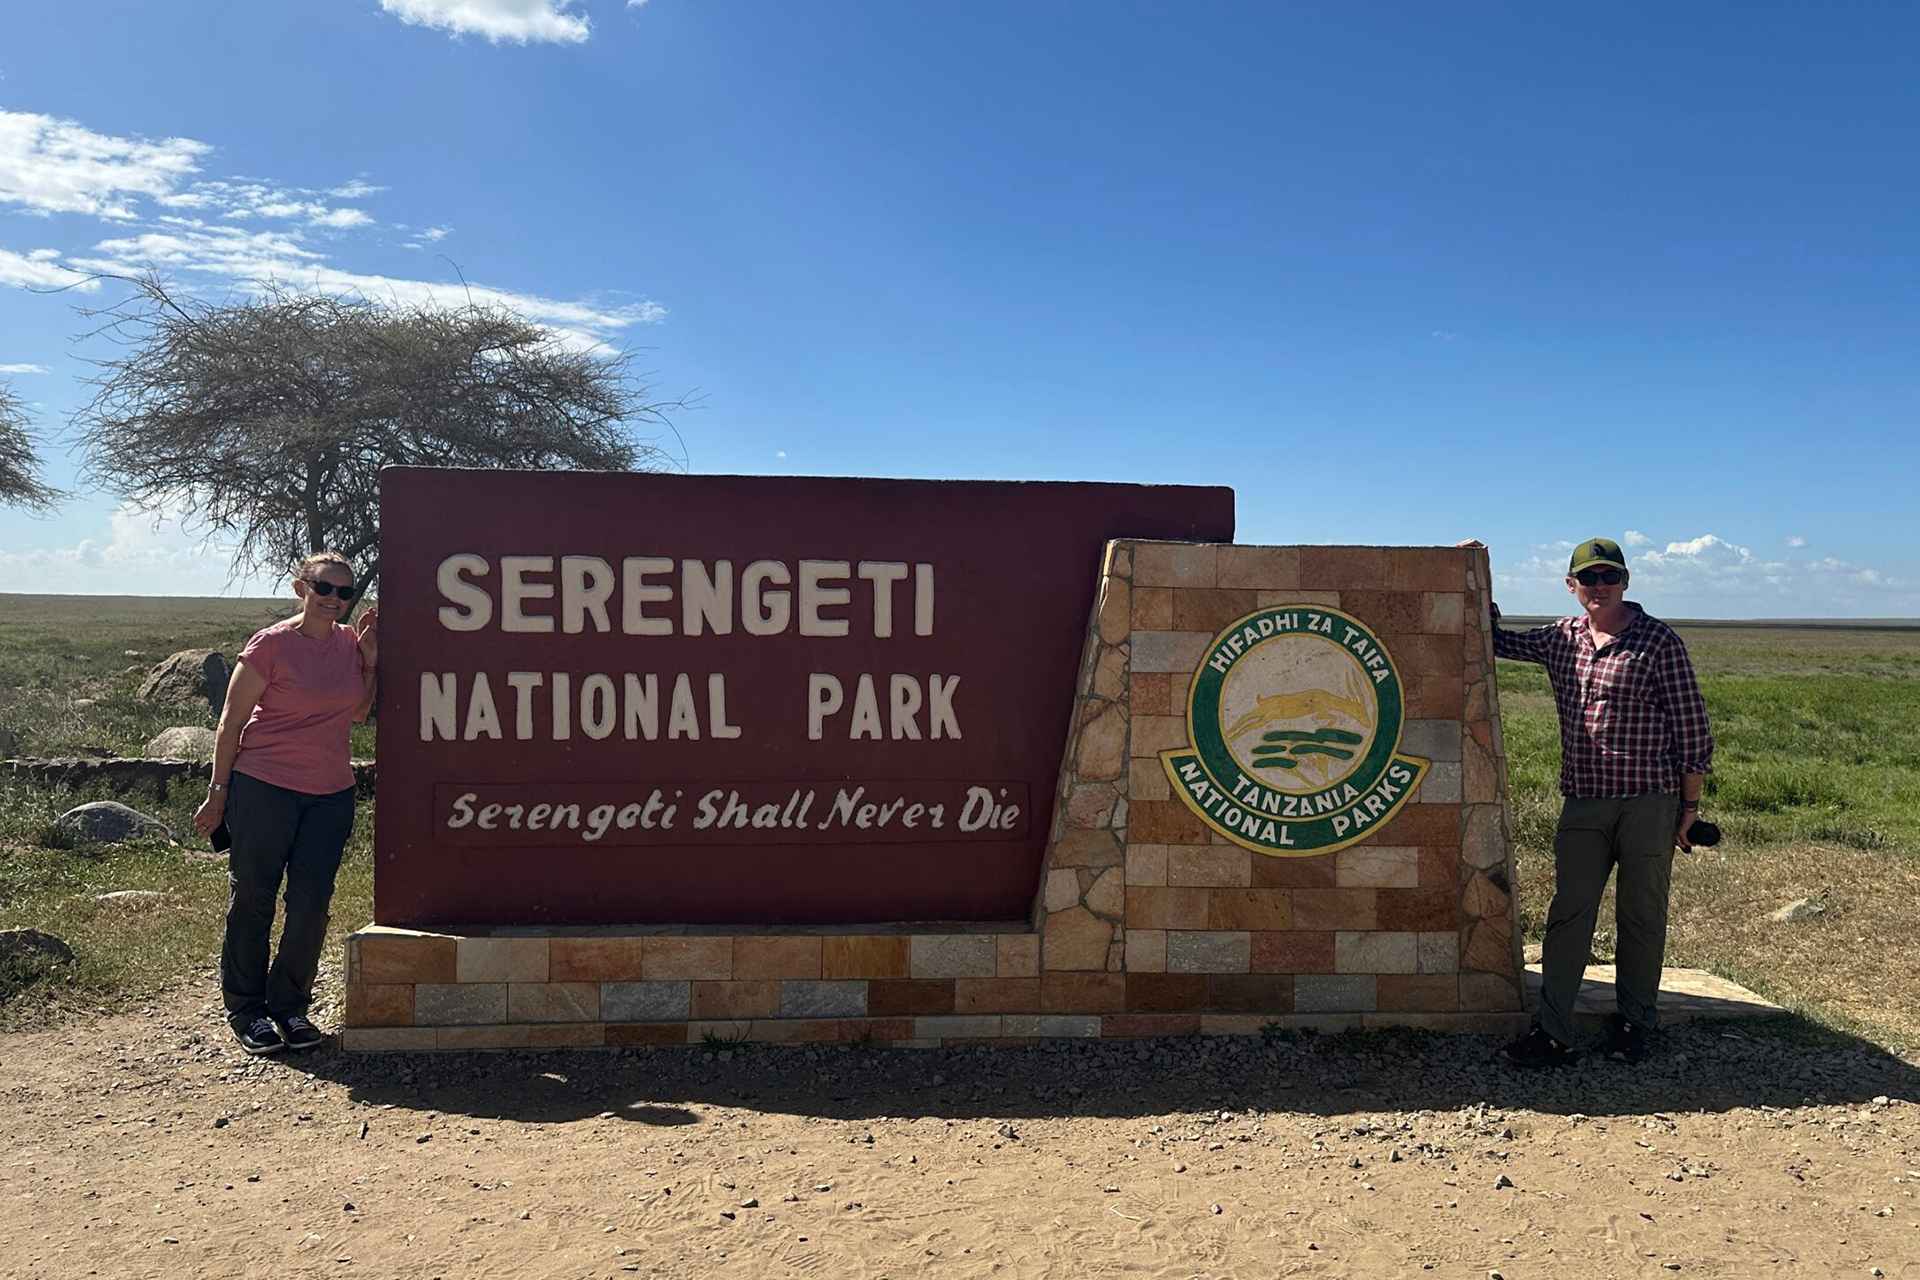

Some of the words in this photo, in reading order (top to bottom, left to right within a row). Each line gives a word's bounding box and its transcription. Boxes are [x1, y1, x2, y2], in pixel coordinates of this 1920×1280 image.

[438, 555, 934, 637] SERENGETI
[1209, 613, 1299, 673] HIFADHI
[1307, 613, 1333, 633] ZA
[1341, 626, 1391, 684] TAIFA
[420, 672, 742, 741] NATIONAL
[808, 673, 962, 740] PARK
[447, 789, 683, 841] Serengeti
[694, 789, 815, 829] Shall
[818, 786, 944, 830] Never
[958, 786, 1019, 832] Die
[1179, 762, 1295, 846] NATIONAL
[1331, 765, 1411, 838] PARKS
[1231, 773, 1359, 817] TANZANIA
